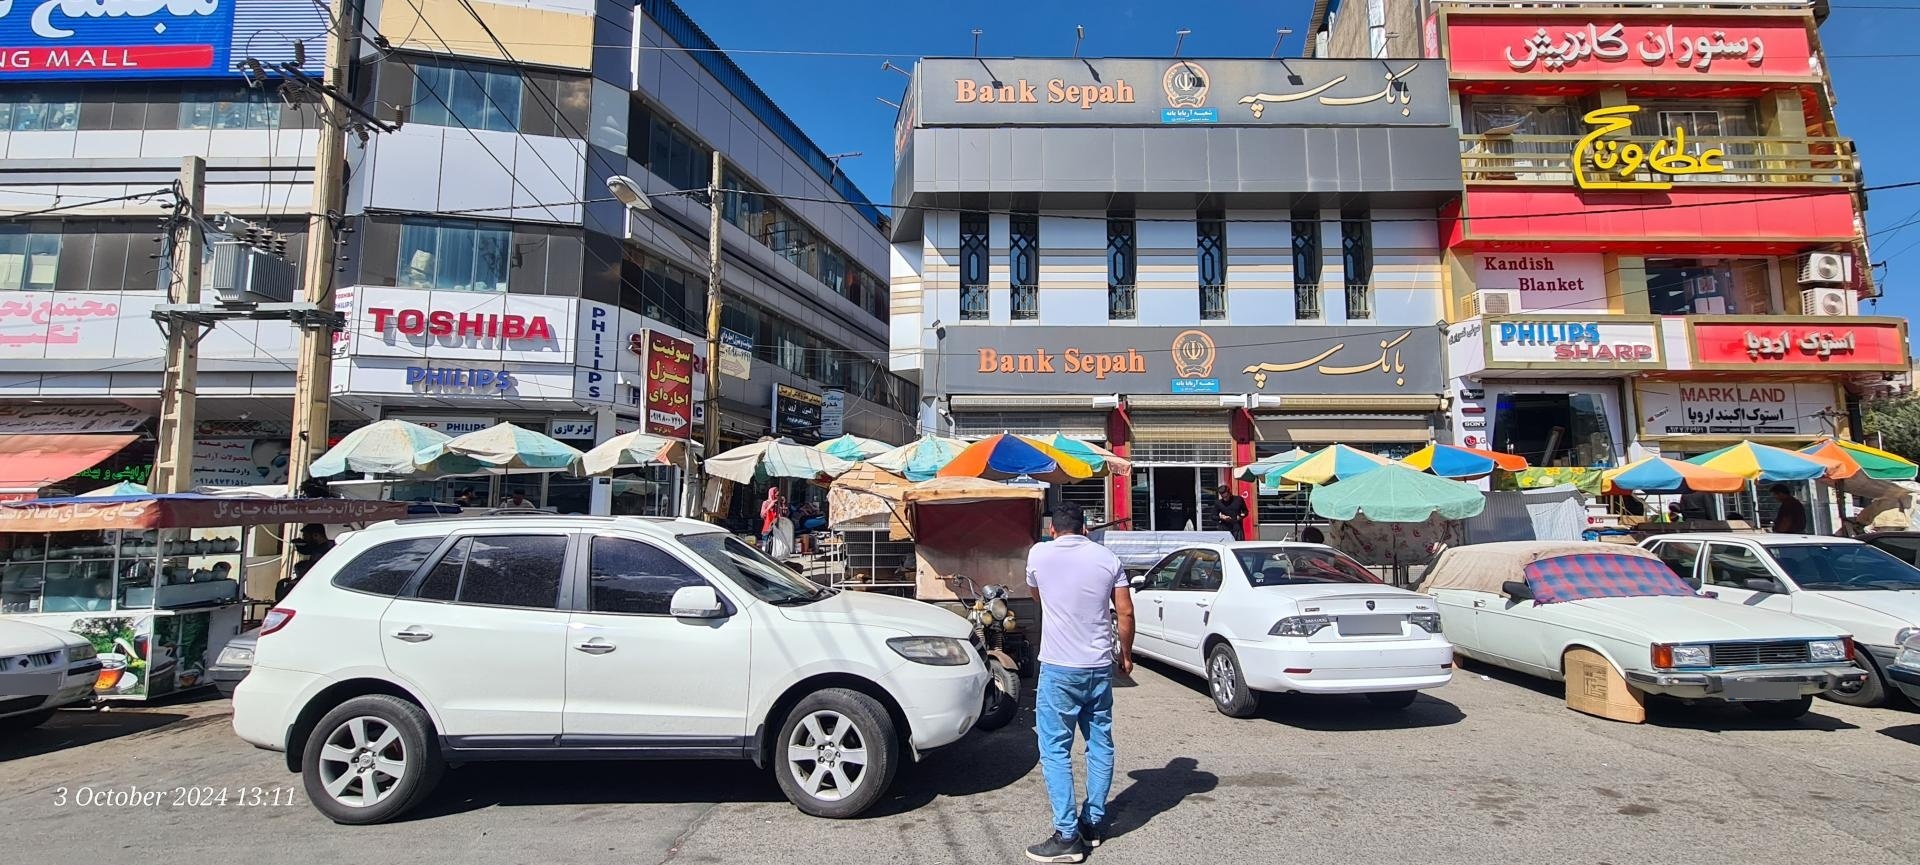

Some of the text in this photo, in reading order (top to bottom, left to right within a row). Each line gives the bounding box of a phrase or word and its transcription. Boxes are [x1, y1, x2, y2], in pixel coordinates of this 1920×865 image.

[46, 50, 138, 68] MALL
[1638, 24, 1763, 70] رستوران
[955, 79, 1136, 109] Bank Sepah
[1238, 62, 1419, 118] بانک سپه
[1483, 256, 1554, 271] Kandish
[1518, 277, 1584, 292] Blanket
[32, 297, 118, 324] مجتمع
[0, 324, 80, 348] نگی
[368, 307, 551, 341] TOSHIBA
[1501, 322, 1600, 346] PHILIPS
[588, 307, 606, 398] PHILIPS
[1318, 330, 1412, 386] بانک
[1555, 343, 1652, 360] SHARP
[1744, 330, 1855, 361] استوک اروپا
[650, 361, 690, 384] منزل
[977, 347, 1146, 379] Bank Sepah
[1242, 343, 1344, 389] سپه
[406, 366, 511, 391] PHILIPS
[447, 423, 487, 431] PHILIPS
[1688, 407, 1714, 424] اروپا
[1746, 407, 1784, 425] استوک
